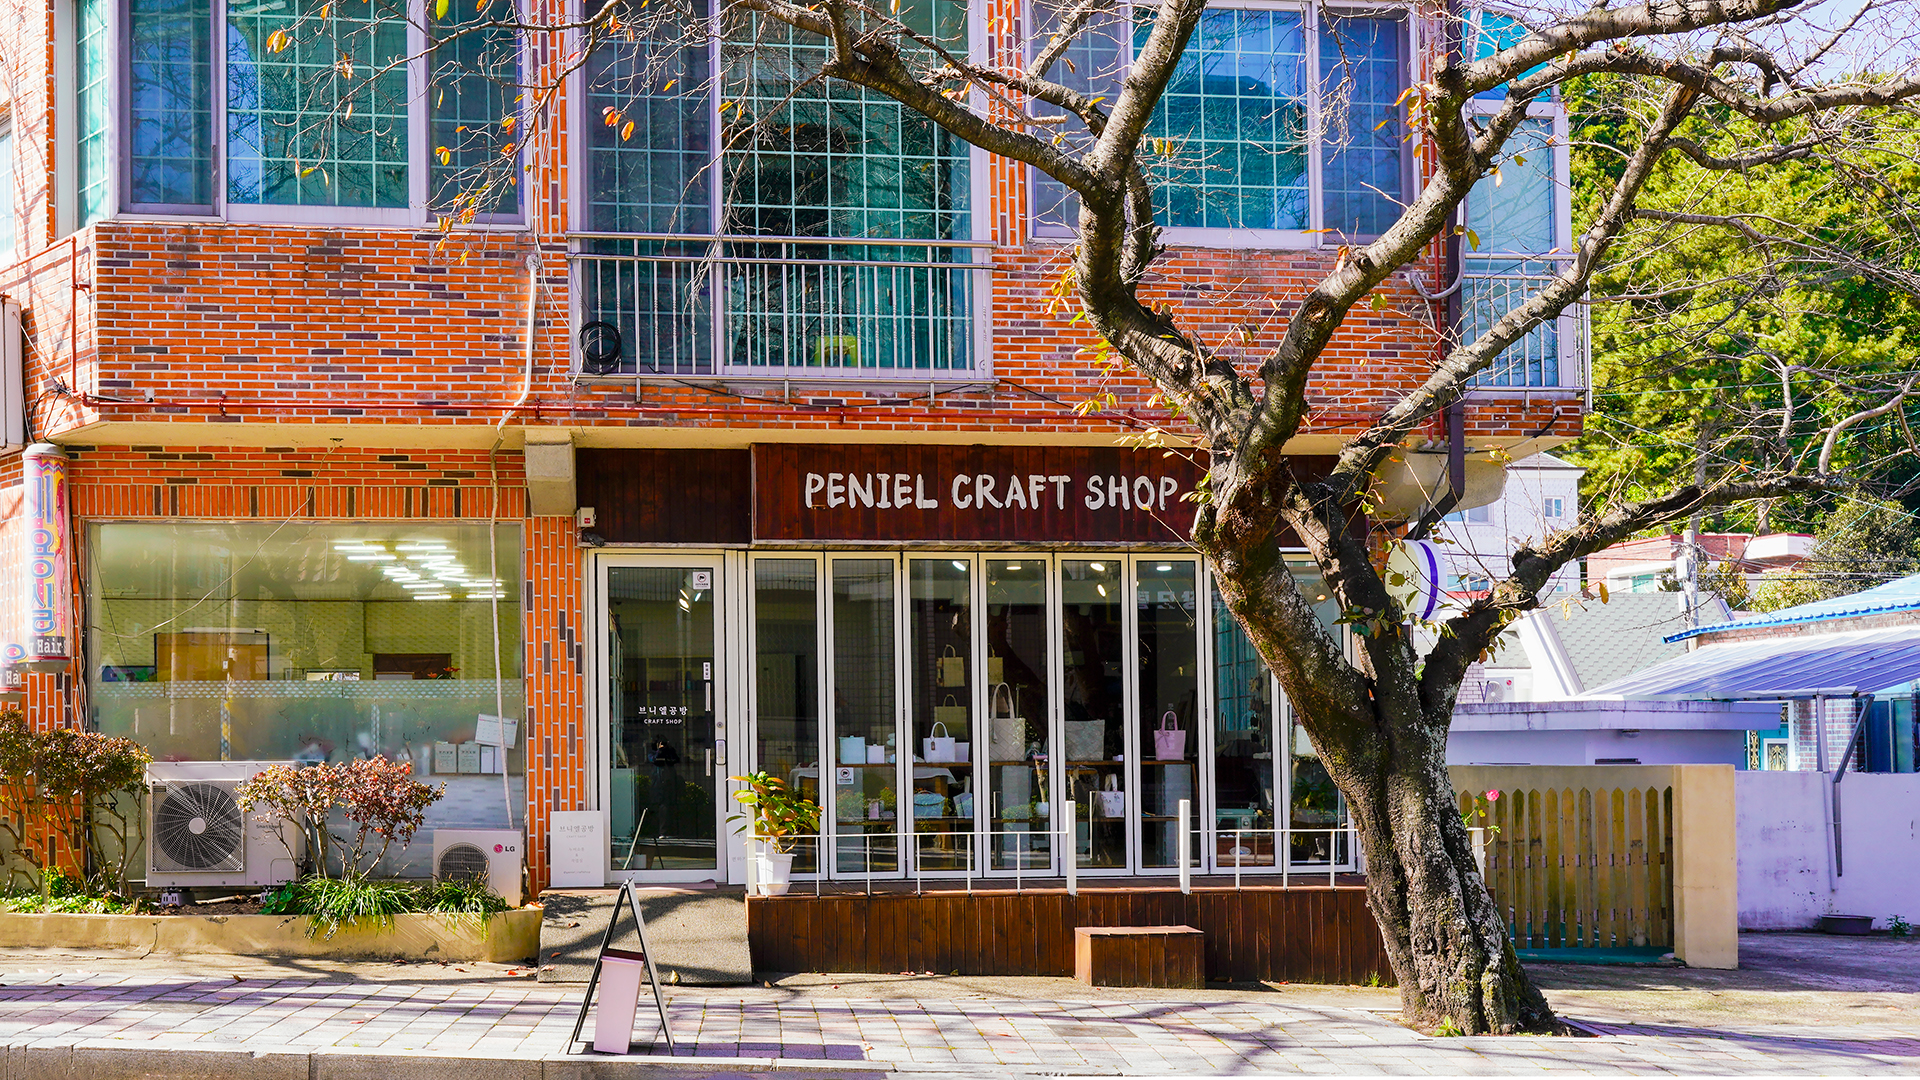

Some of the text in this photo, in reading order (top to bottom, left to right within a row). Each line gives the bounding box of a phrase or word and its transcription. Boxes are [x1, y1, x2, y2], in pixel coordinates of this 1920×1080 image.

[804, 472, 1179, 512] PENIEL CRAFT SHOP
[29, 474, 57, 634] 미용실
[37, 638, 62, 654] Hair
[638, 705, 687, 715] 브니엘공방
